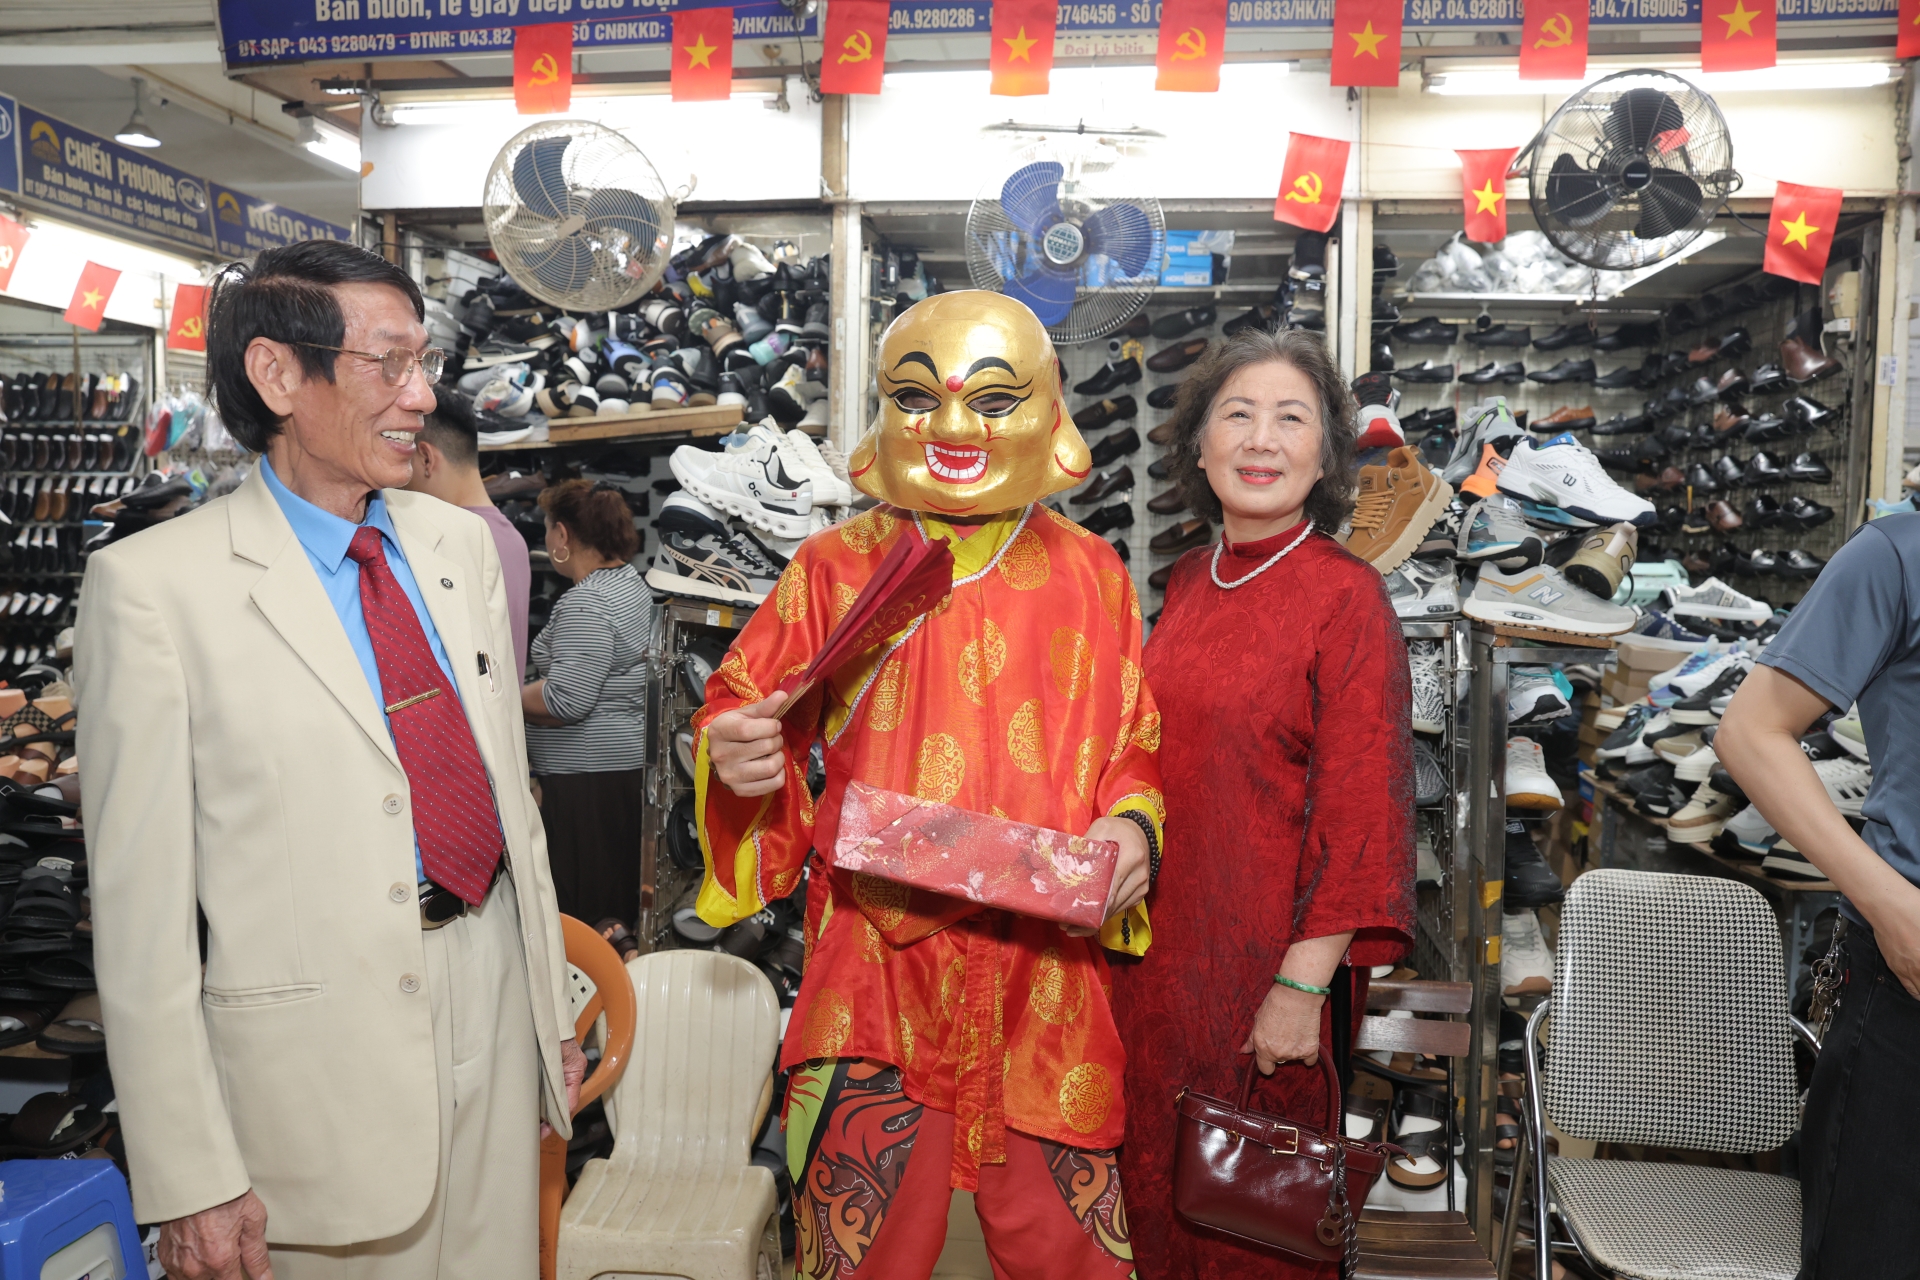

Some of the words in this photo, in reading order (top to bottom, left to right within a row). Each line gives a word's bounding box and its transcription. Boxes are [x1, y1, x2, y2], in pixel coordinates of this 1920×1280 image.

[260, 37, 295, 60] SẠP:
[299, 36, 328, 54] 043
[331, 33, 395, 53] 9280479
[410, 31, 455, 49] ĐTNR:
[594, 22, 666, 41] CNĐKKD:
[64, 136, 113, 181] CHIẾN
[117, 157, 176, 202] PHƯƠNG
[246, 203, 309, 244] NGỌC
